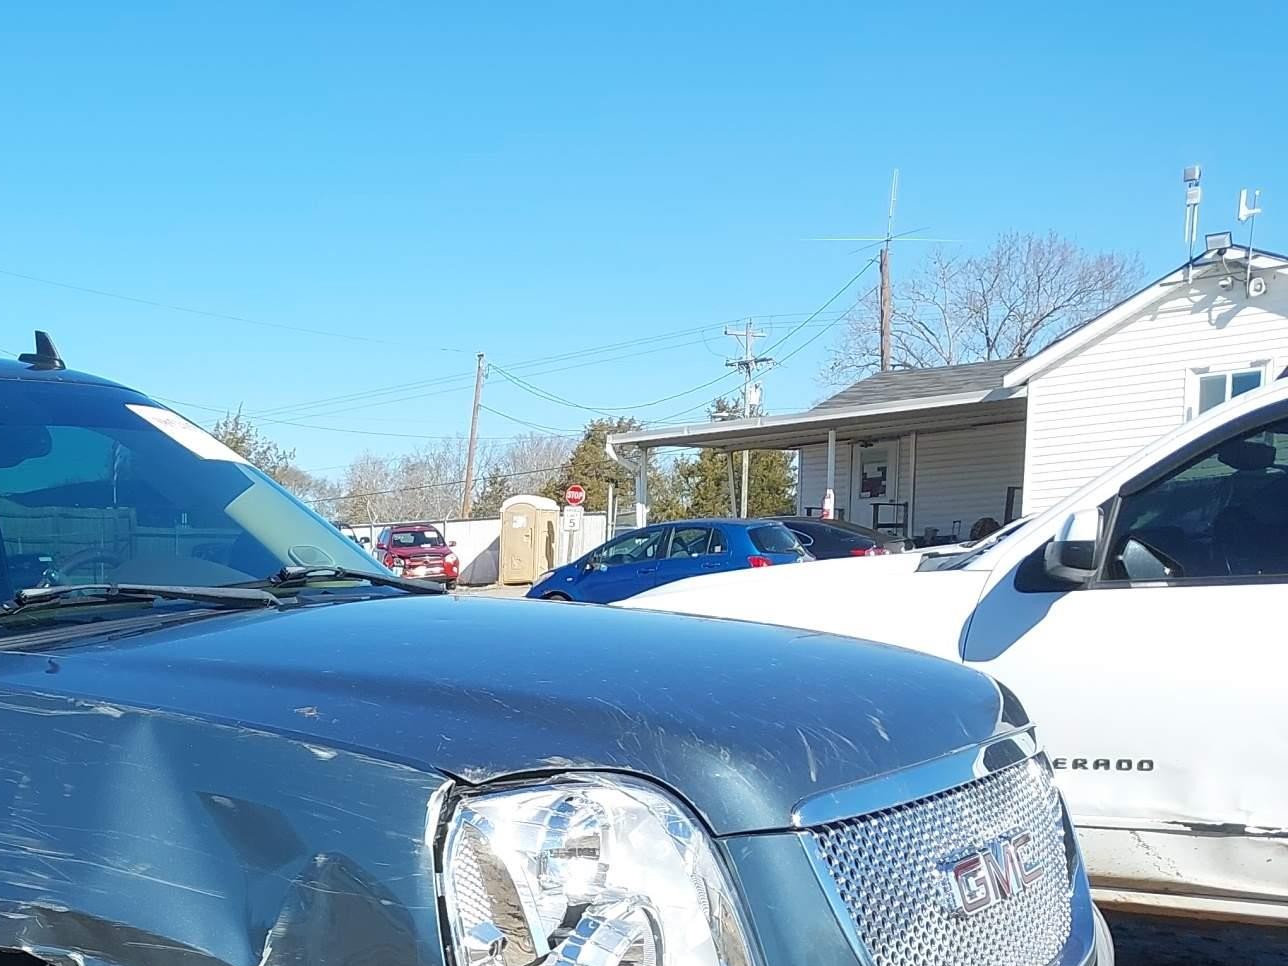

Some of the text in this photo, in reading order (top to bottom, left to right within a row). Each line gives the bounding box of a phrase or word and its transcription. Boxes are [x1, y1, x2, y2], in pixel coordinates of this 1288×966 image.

[567, 491, 583, 499] STOP
[569, 519, 576, 528] 5
[953, 830, 1044, 914] GMC
